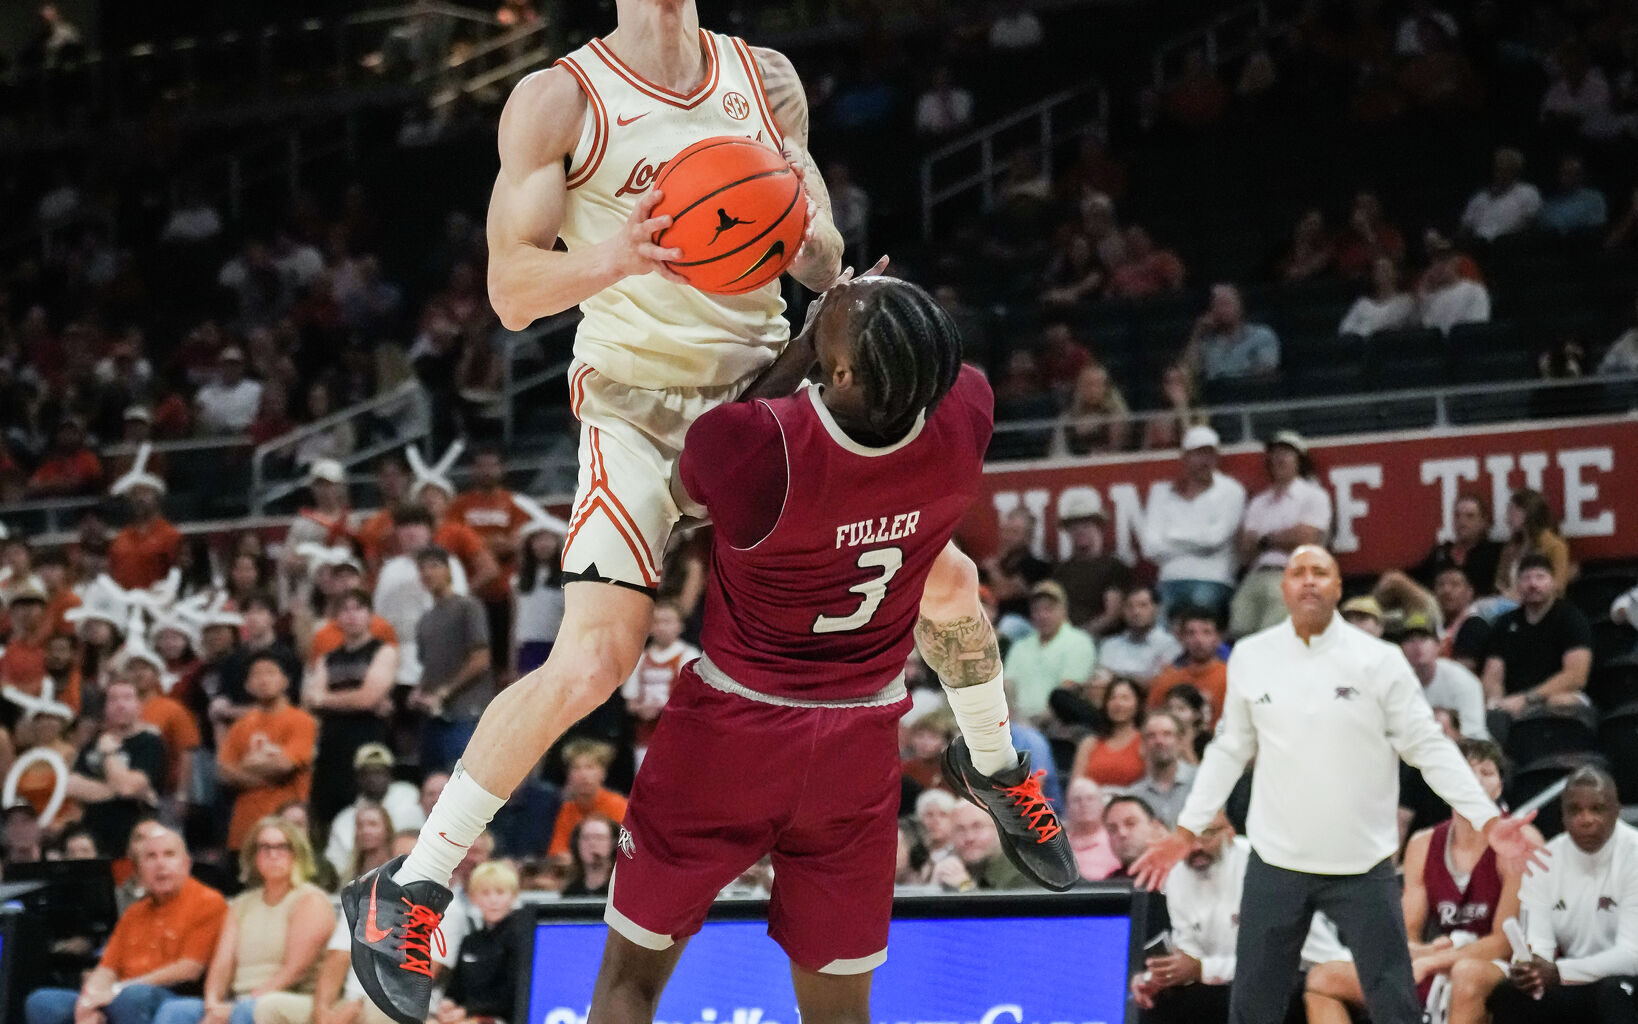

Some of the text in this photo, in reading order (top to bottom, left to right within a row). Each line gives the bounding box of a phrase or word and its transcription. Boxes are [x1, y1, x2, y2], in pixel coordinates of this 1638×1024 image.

[723, 92, 749, 120] SEC
[1420, 447, 1614, 544] THE
[836, 510, 920, 549] FULLER
[812, 547, 903, 633] 3
